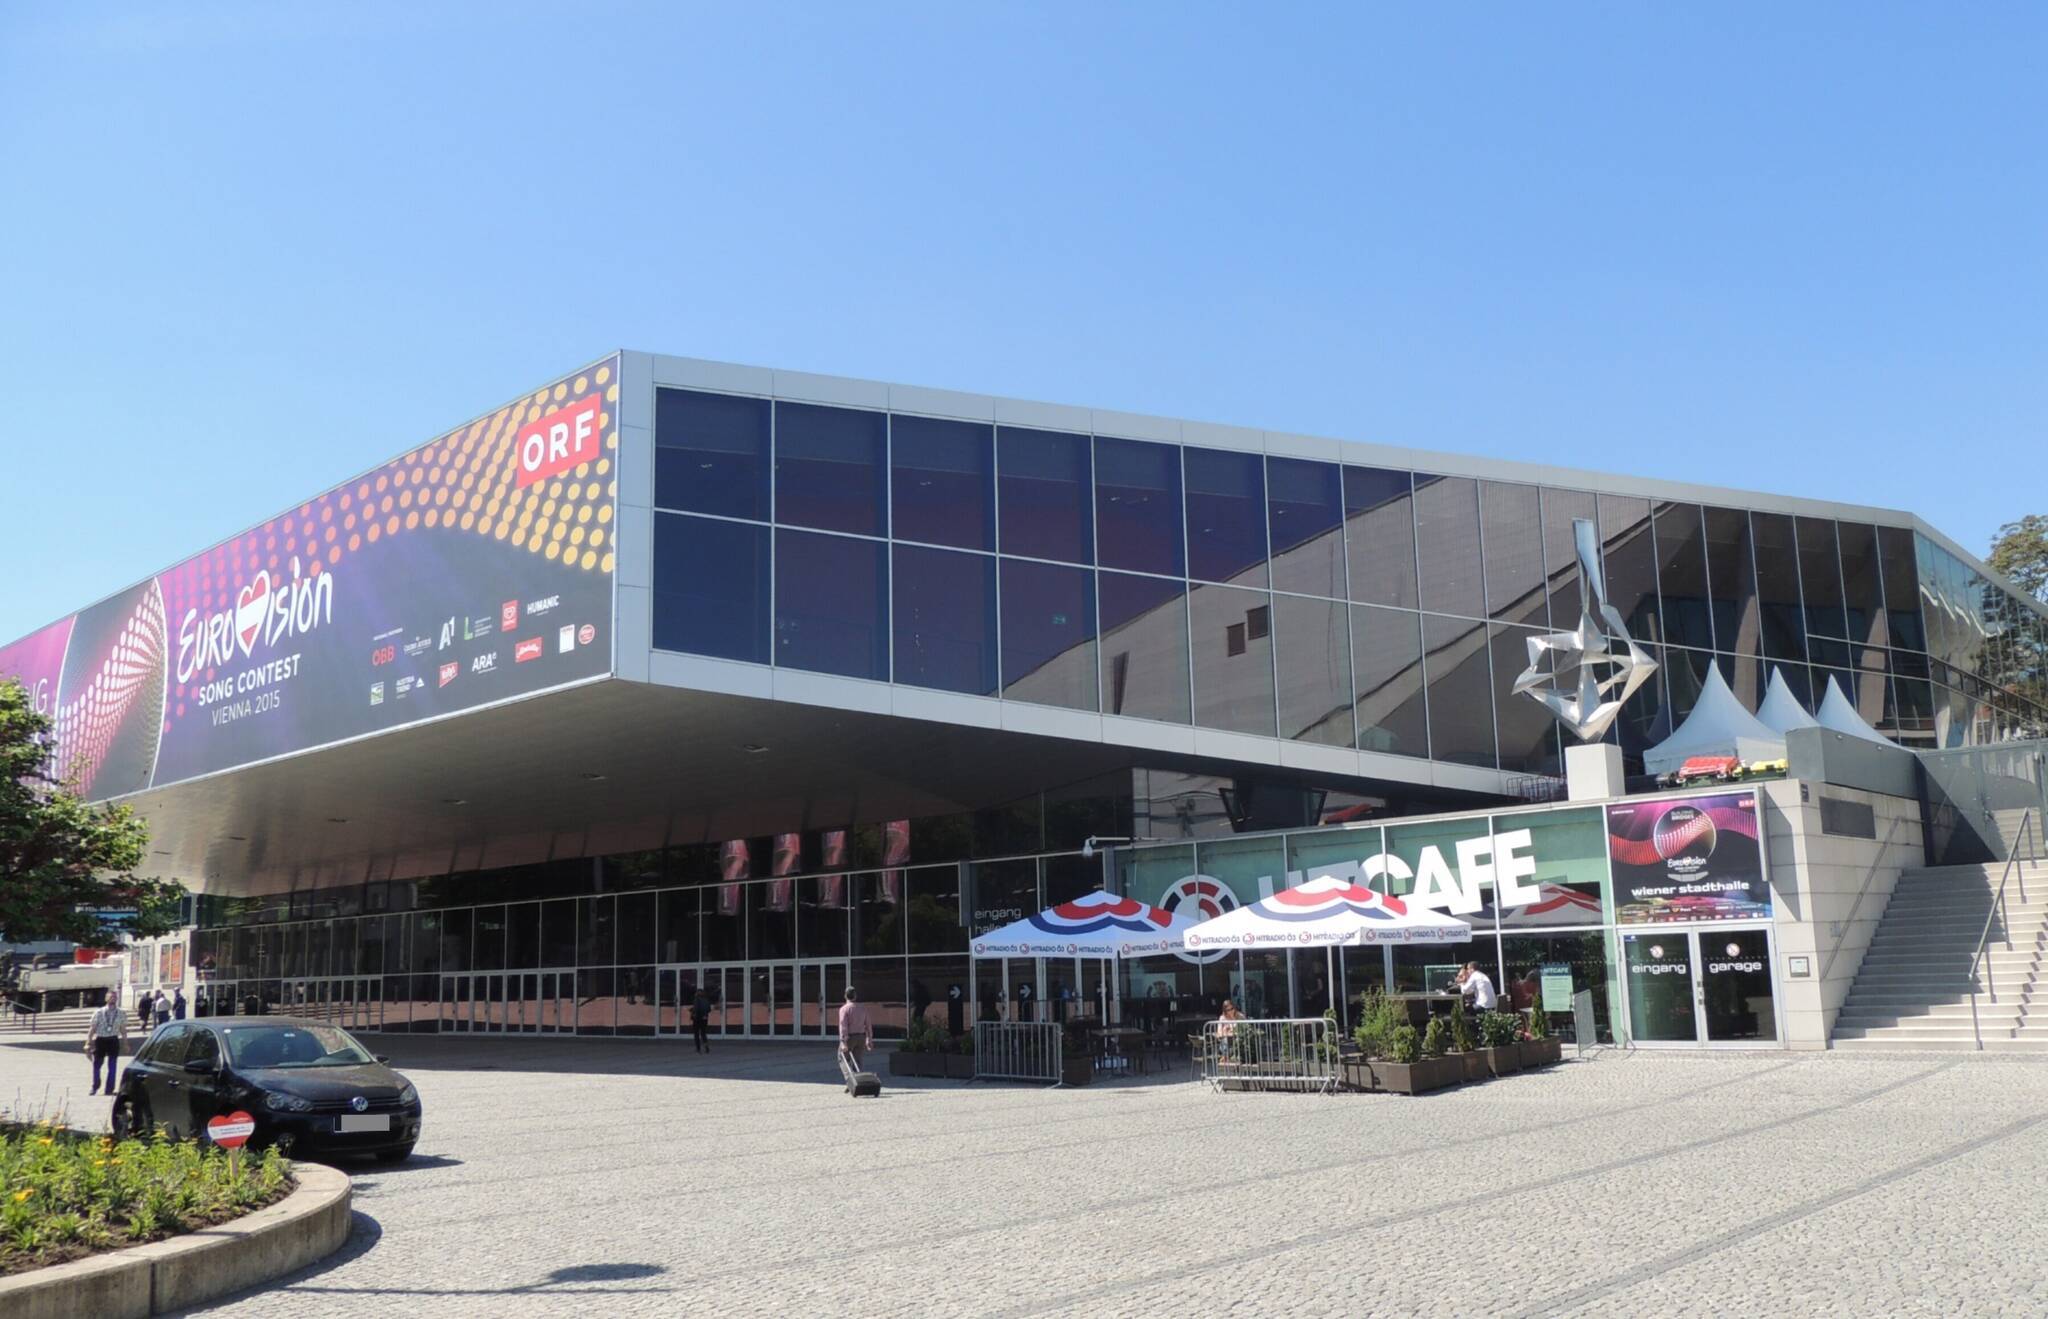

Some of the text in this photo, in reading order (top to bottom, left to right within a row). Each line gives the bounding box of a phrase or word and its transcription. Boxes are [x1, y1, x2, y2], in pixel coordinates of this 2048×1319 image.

[523, 409, 594, 472] ORF
[526, 595, 559, 614] HUMANIC
[439, 616, 455, 650] A1
[198, 653, 301, 706] SONG CONTEST
[212, 690, 281, 727] VIENNA 2015
[1631, 881, 1750, 897] wiener stadthalle
[974, 907, 1022, 921] eingang
[1202, 936, 1231, 944] HITRADIO
[1256, 934, 1287, 942] HITRADIO
[1632, 964, 1686, 974] eingang
[1709, 962, 1762, 973] garage
